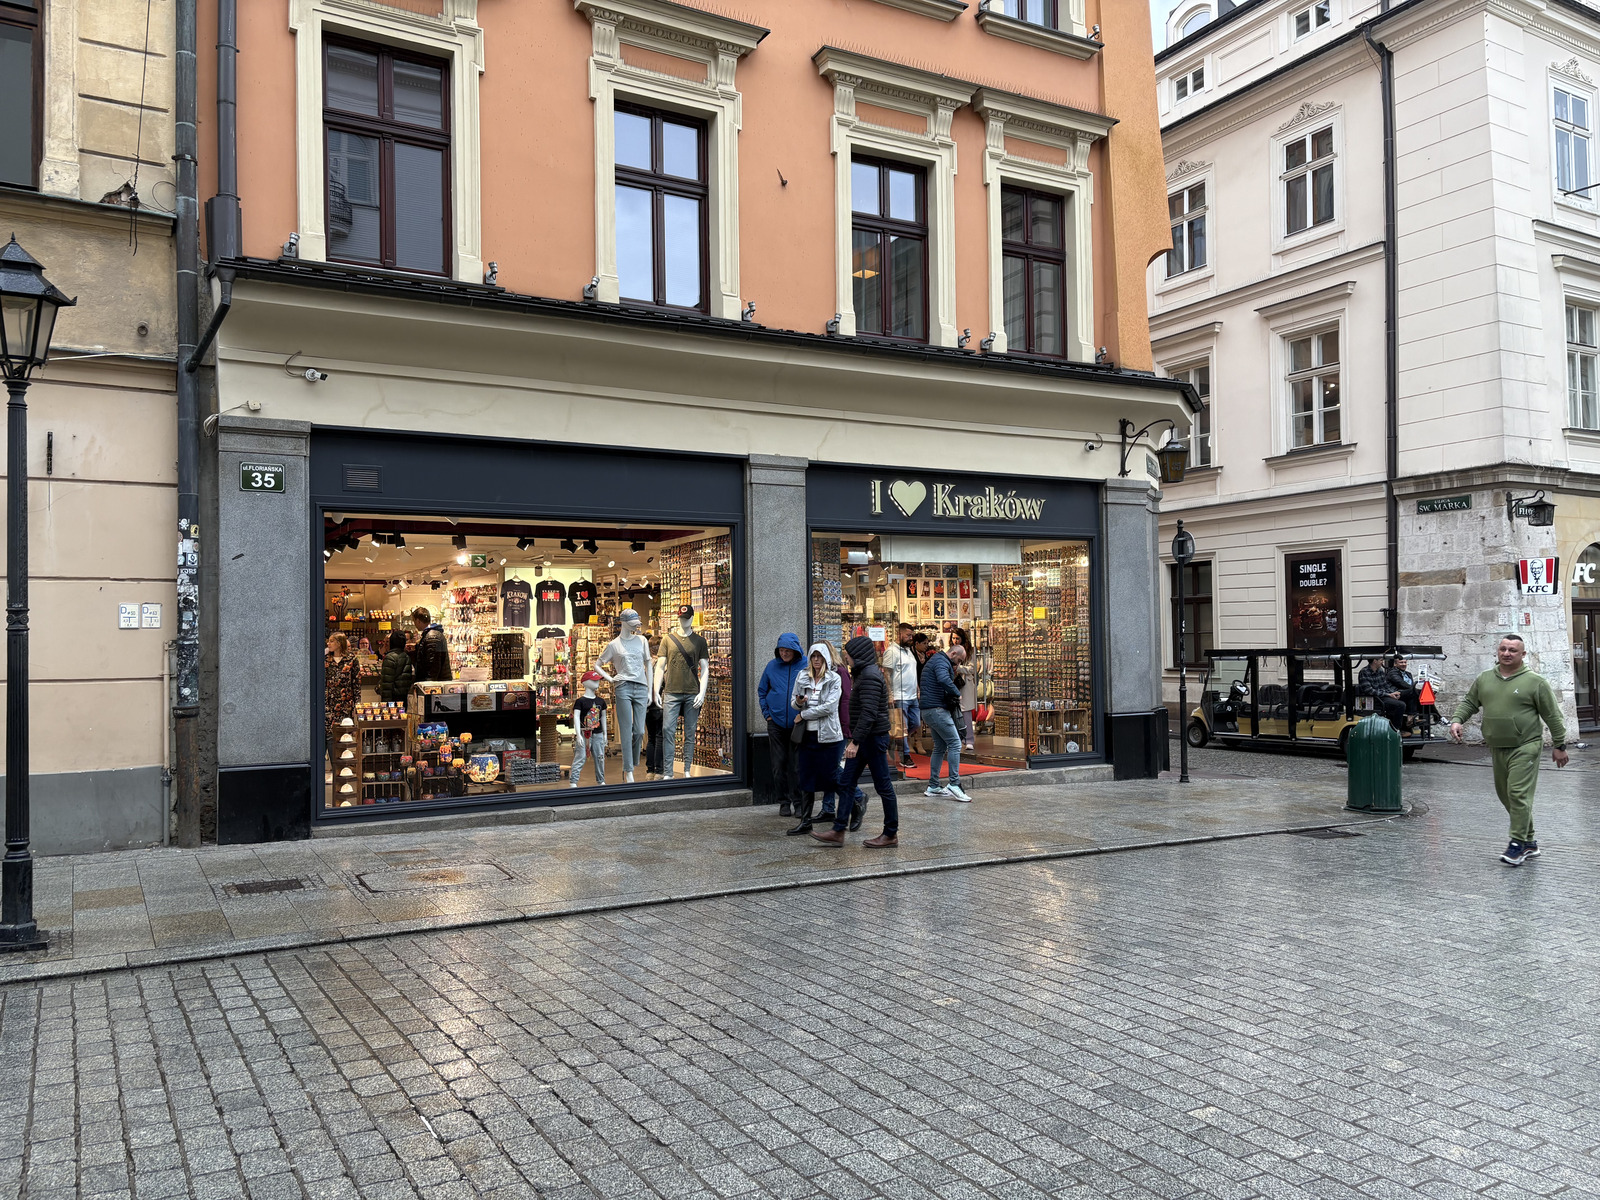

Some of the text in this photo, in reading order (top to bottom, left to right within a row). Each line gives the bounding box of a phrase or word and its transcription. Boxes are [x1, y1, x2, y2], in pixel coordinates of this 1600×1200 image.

[250, 472, 276, 488] 35
[871, 480, 1047, 521] I Kraków
[1433, 501, 1468, 511] MARKA
[1299, 563, 1327, 573] SINGLE
[1571, 563, 1596, 583] FC
[1299, 578, 1328, 587] DOUBLE?
[1527, 585, 1549, 593] KFC
